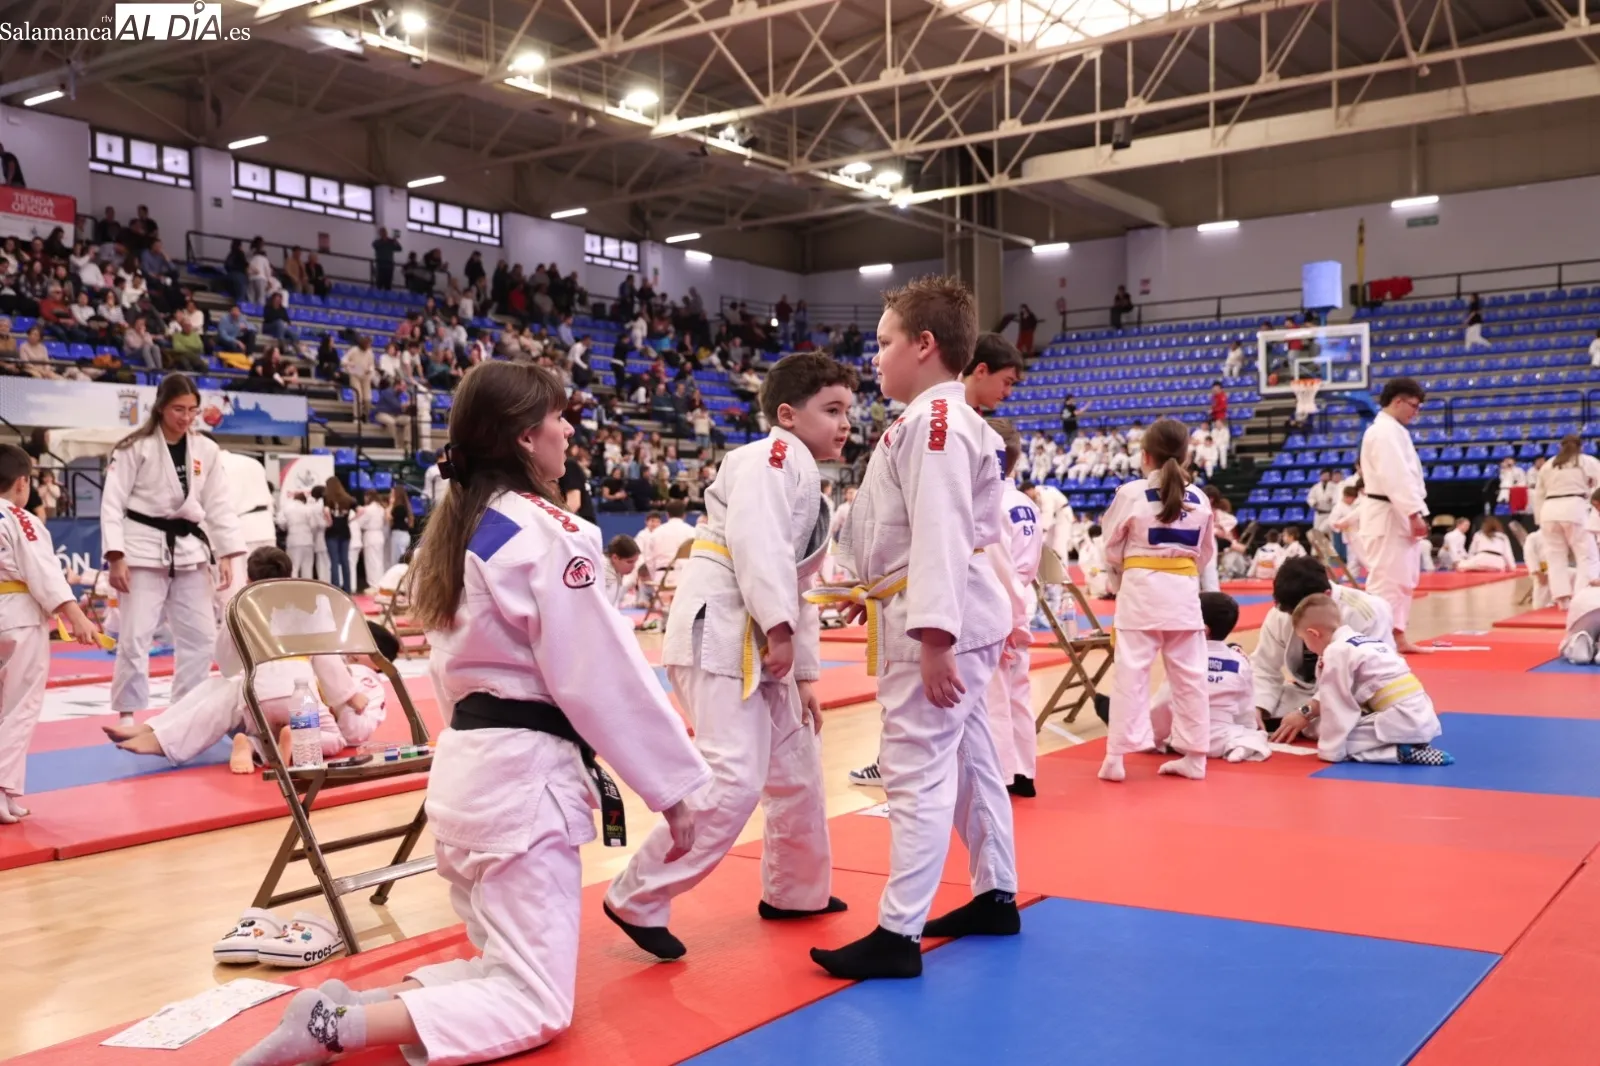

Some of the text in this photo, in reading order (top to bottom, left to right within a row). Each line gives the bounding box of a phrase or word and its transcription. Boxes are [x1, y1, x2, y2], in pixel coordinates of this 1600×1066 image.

[13, 191, 54, 208] TIENDA
[11, 201, 57, 218] OFICIAL
[303, 944, 332, 962] crocs
